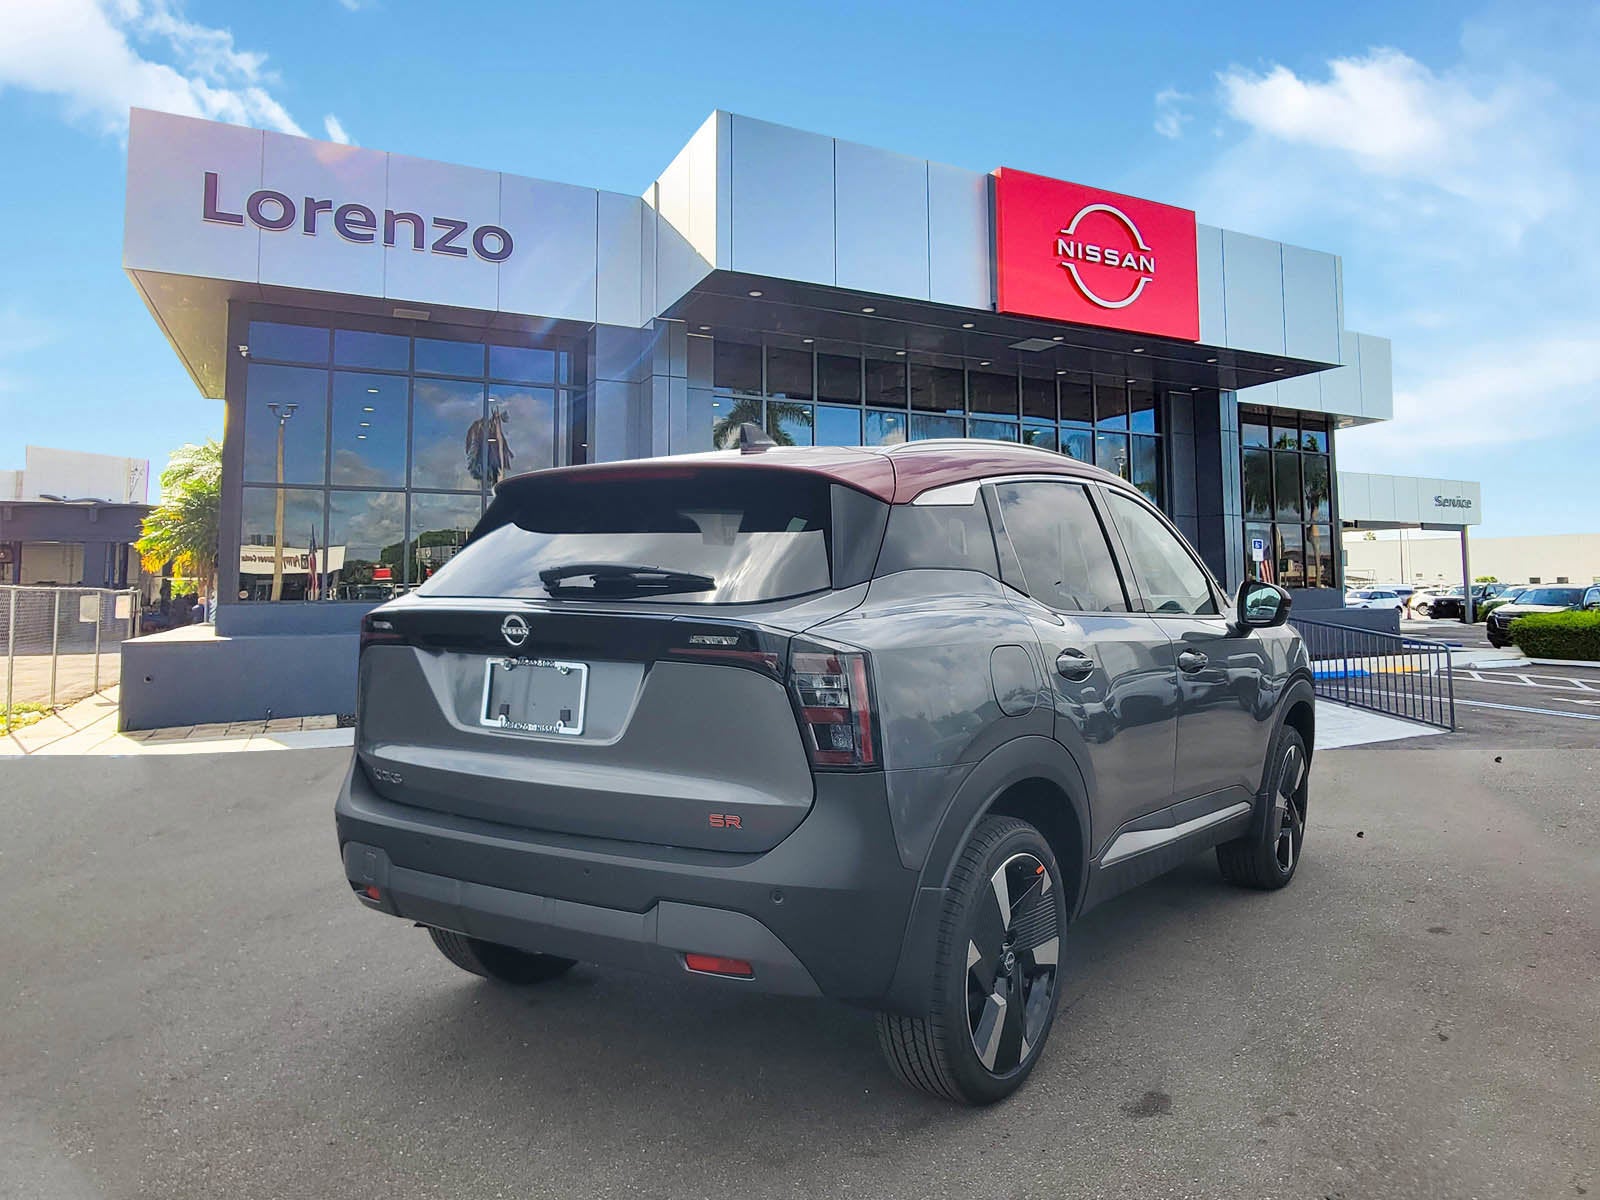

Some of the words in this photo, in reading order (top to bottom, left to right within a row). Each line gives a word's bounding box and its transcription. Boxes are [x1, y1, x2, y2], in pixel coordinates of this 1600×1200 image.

[203, 171, 514, 262] Lorenzo
[1057, 238, 1155, 273] NISSAN
[1434, 495, 1472, 509] Service
[501, 625, 529, 635] NISSAN
[709, 813, 742, 829] SR
